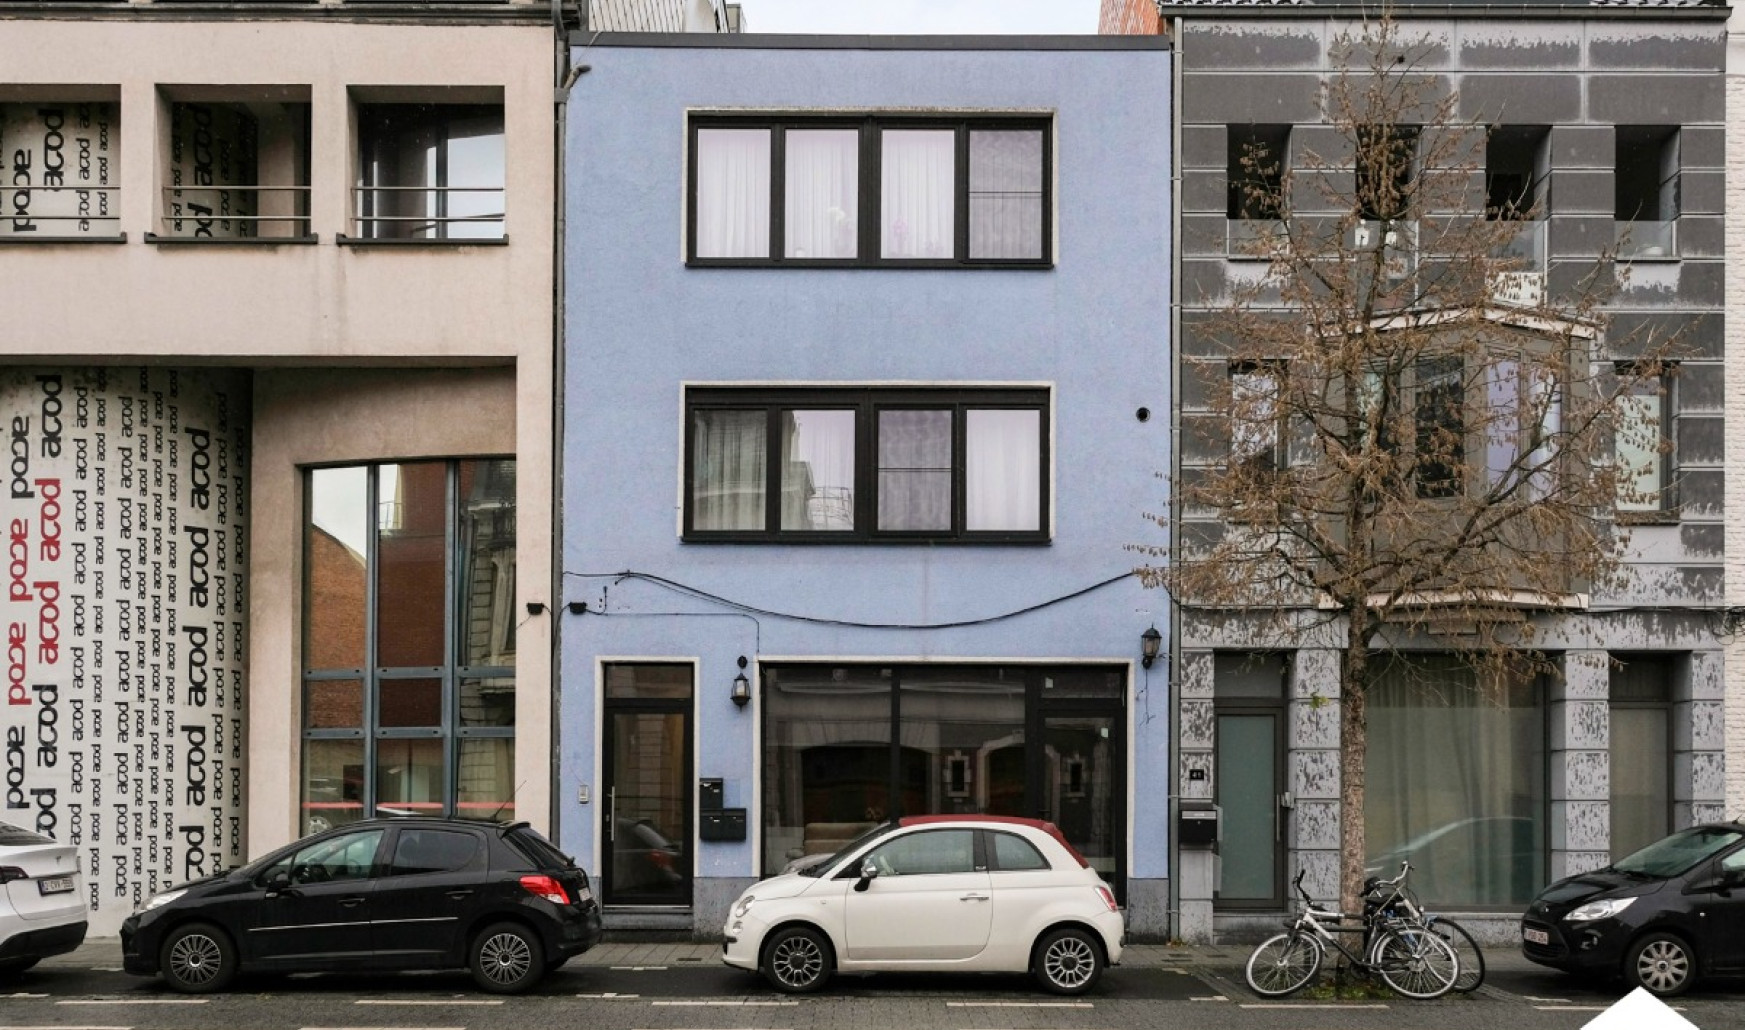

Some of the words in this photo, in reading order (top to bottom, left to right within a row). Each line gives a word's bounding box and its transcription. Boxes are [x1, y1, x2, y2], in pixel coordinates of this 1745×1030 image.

[76, 138, 90, 180] acod
[35, 374, 62, 458] acod
[74, 386, 88, 428] acod
[118, 396, 132, 438] acod
[11, 416, 35, 499] acod
[73, 438, 87, 480] acod
[118, 446, 132, 488] acod
[184, 427, 210, 510] acod
[35, 478, 61, 561] acod
[72, 490, 86, 532] acod
[117, 498, 132, 539] acod
[10, 518, 33, 602] acod
[71, 542, 86, 584] acod
[116, 548, 131, 590] acod
[184, 526, 209, 608] acod
[33, 581, 60, 664] acod
[71, 595, 84, 636] acod
[116, 600, 130, 641] acod
[8, 622, 32, 705] acod
[70, 647, 84, 689] acod
[115, 651, 130, 692] acod
[182, 626, 208, 707] acod
[32, 684, 58, 768] acod
[70, 699, 83, 741] acod
[114, 702, 129, 743] acod
[7, 726, 30, 809] acod
[68, 752, 83, 793] acod
[114, 753, 128, 794] acod
[180, 725, 206, 806] acod
[68, 804, 82, 845] acod
[113, 804, 128, 845] acod
[112, 856, 127, 897] acod
